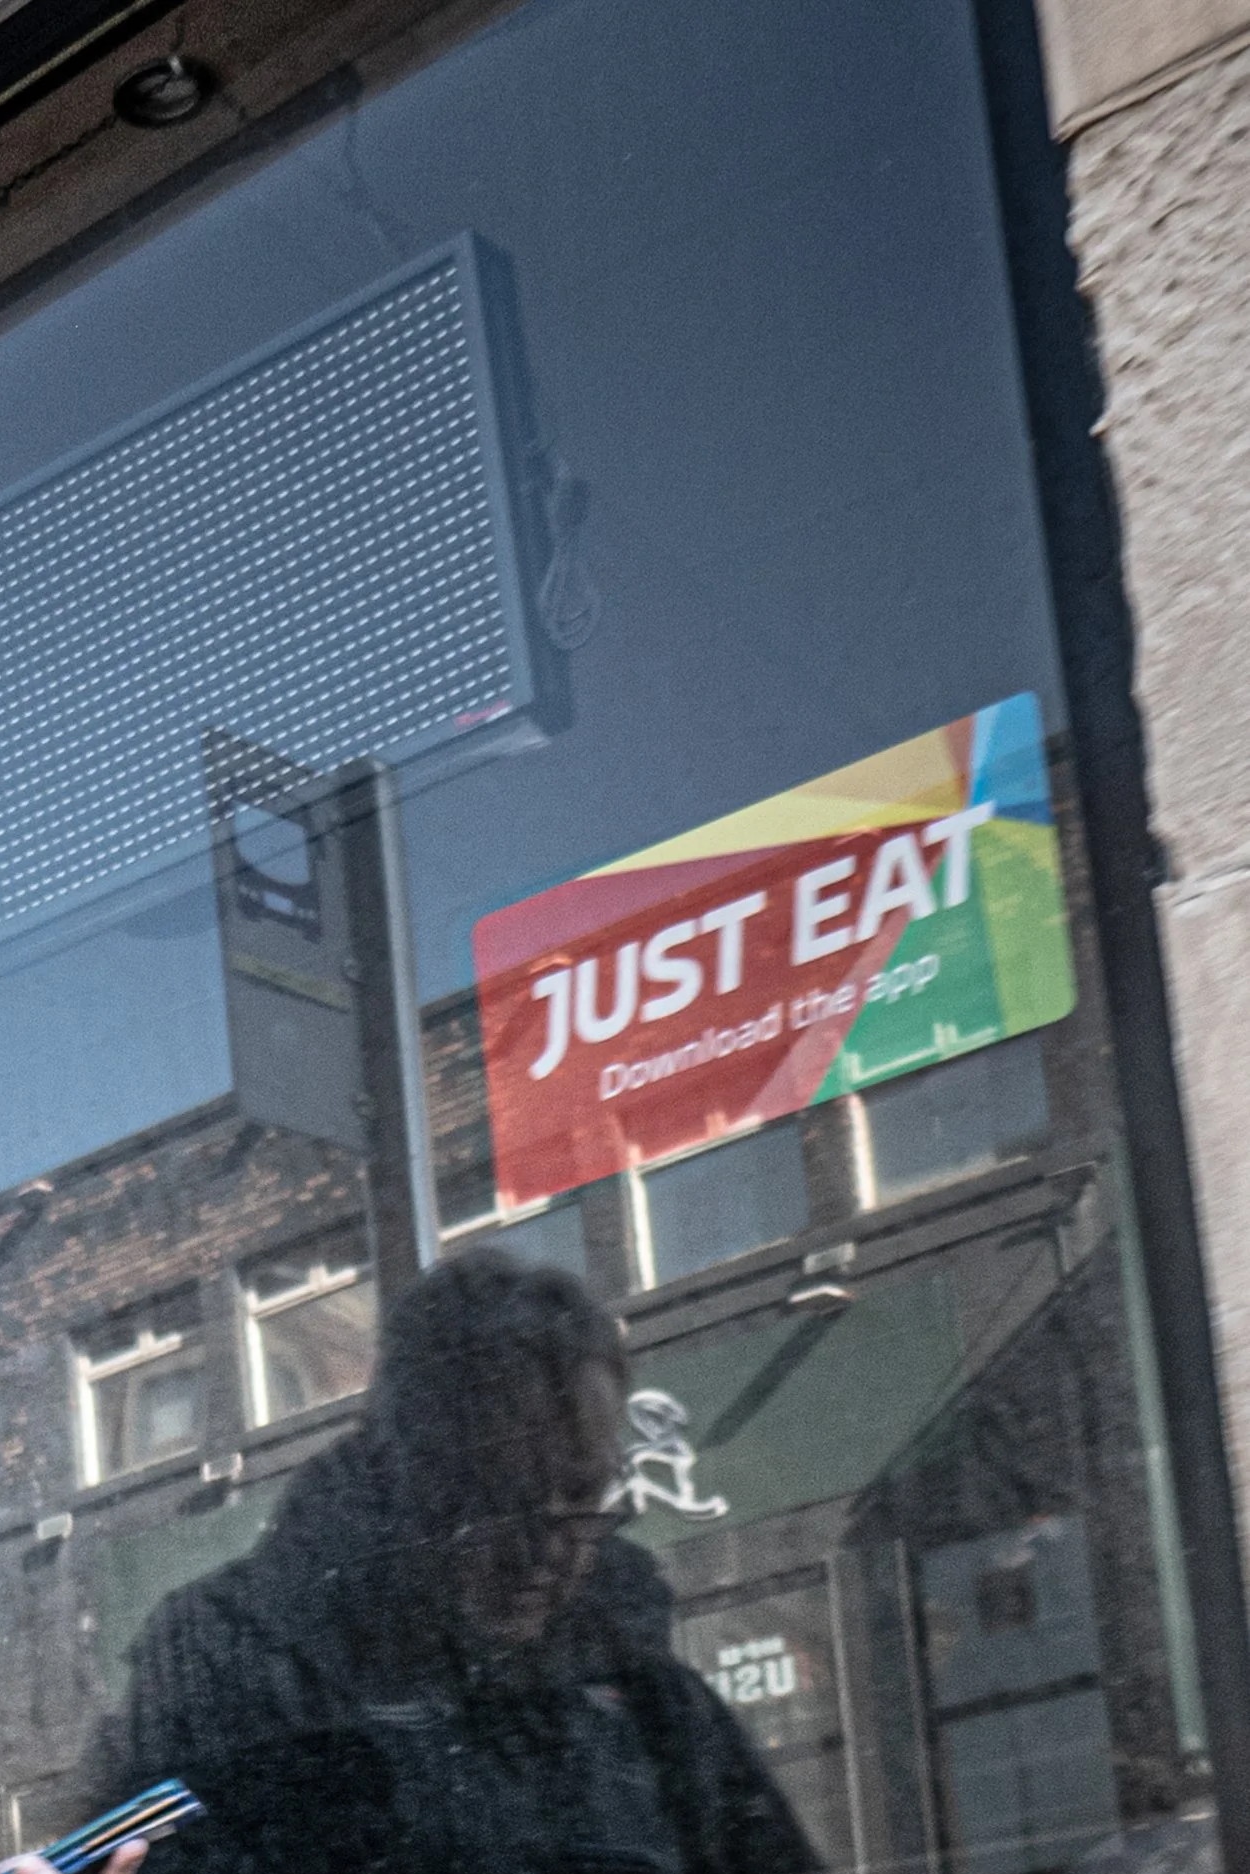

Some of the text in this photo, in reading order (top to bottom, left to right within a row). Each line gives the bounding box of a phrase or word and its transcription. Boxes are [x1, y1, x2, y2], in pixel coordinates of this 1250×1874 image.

[528, 801, 997, 1082] JUST EAT
[599, 953, 941, 1101] Download the app
